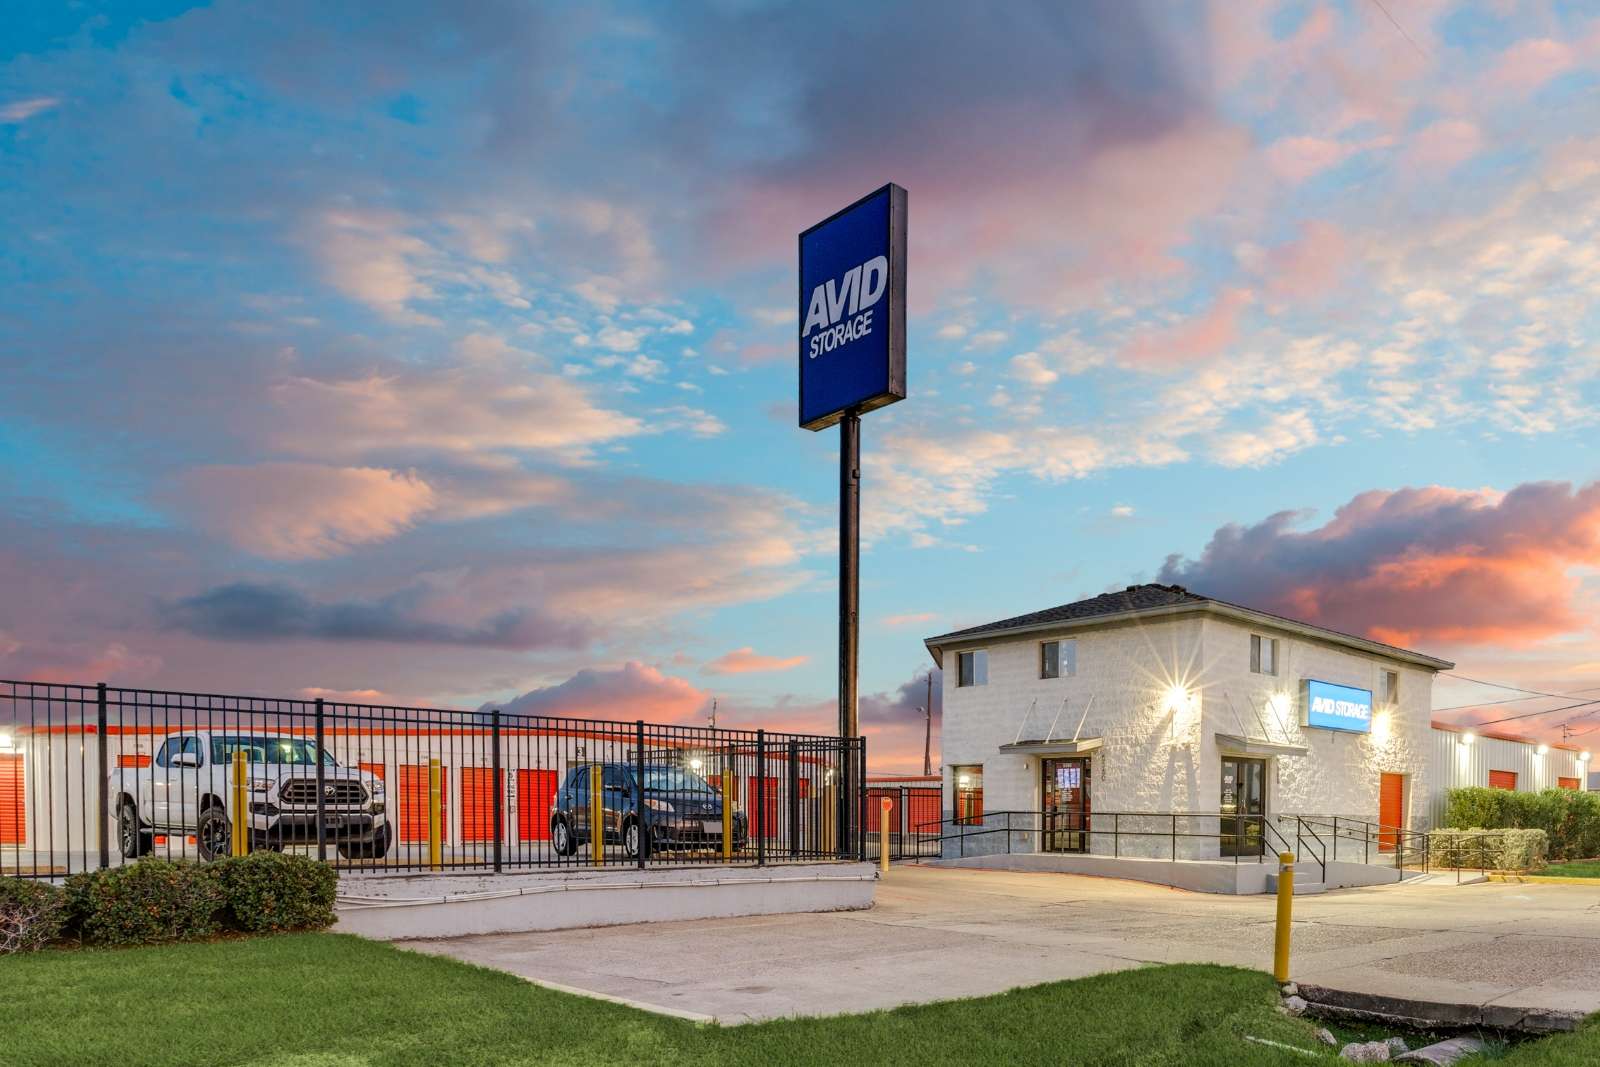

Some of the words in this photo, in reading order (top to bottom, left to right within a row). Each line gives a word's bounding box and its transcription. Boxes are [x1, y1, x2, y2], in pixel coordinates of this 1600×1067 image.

[802, 255, 888, 337] AVID
[809, 309, 873, 359] STORAGE
[1312, 696, 1335, 714] AVID
[1335, 700, 1369, 719] STORAGE
